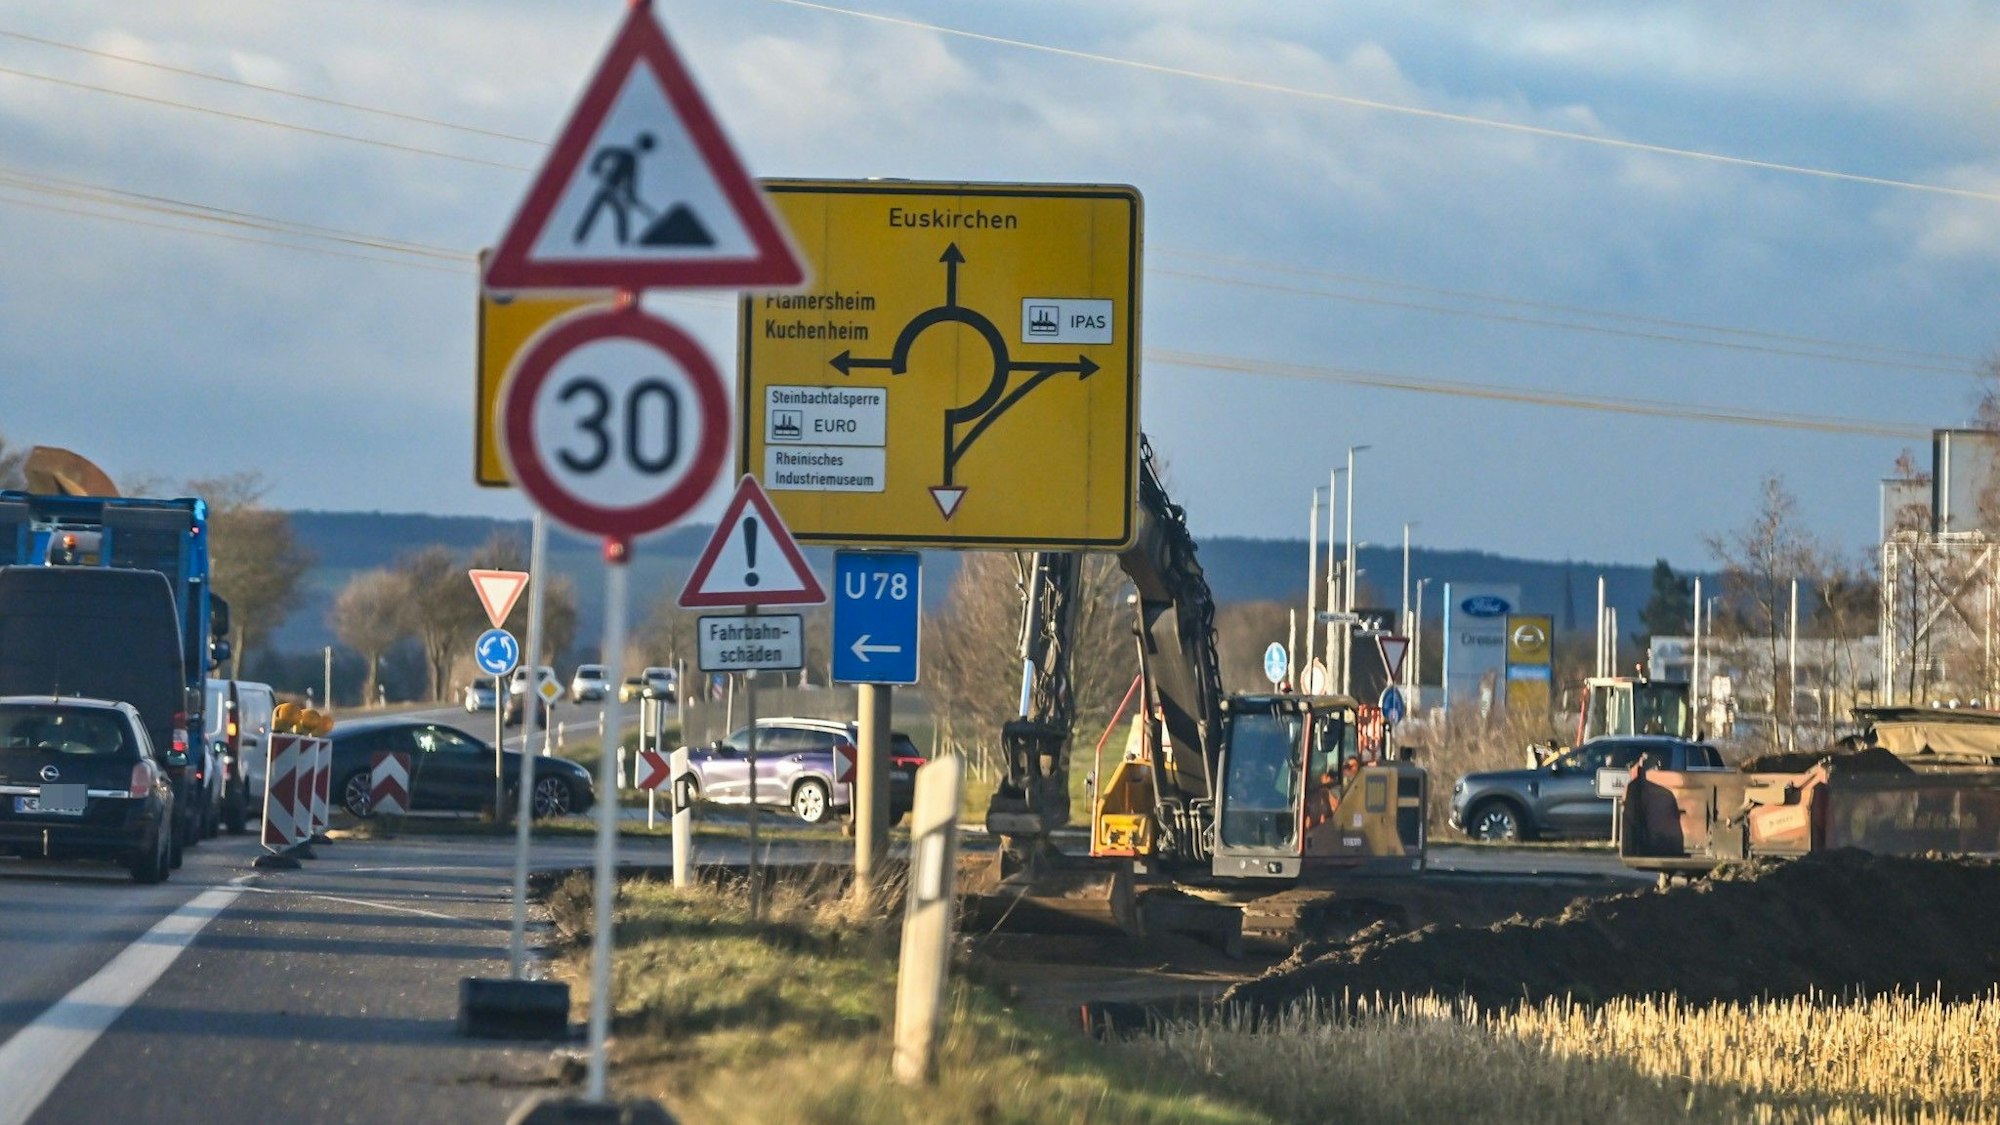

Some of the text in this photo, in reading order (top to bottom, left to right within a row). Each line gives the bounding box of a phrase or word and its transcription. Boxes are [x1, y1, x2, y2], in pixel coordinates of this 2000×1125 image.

[889, 207, 1017, 229] Euskirchen
[765, 319, 869, 340] Kuchenheim
[1070, 315, 1106, 329] IPAS
[772, 390, 880, 408] Steinbachtalsperre
[558, 376, 681, 475] 30
[814, 419, 857, 433] EURO
[775, 452, 844, 466] Rheinisches
[775, 471, 874, 486] Industriemuseum
[845, 571, 908, 601] U 78
[710, 623, 790, 641] Fahrbahn-
[719, 645, 782, 664] schäden
